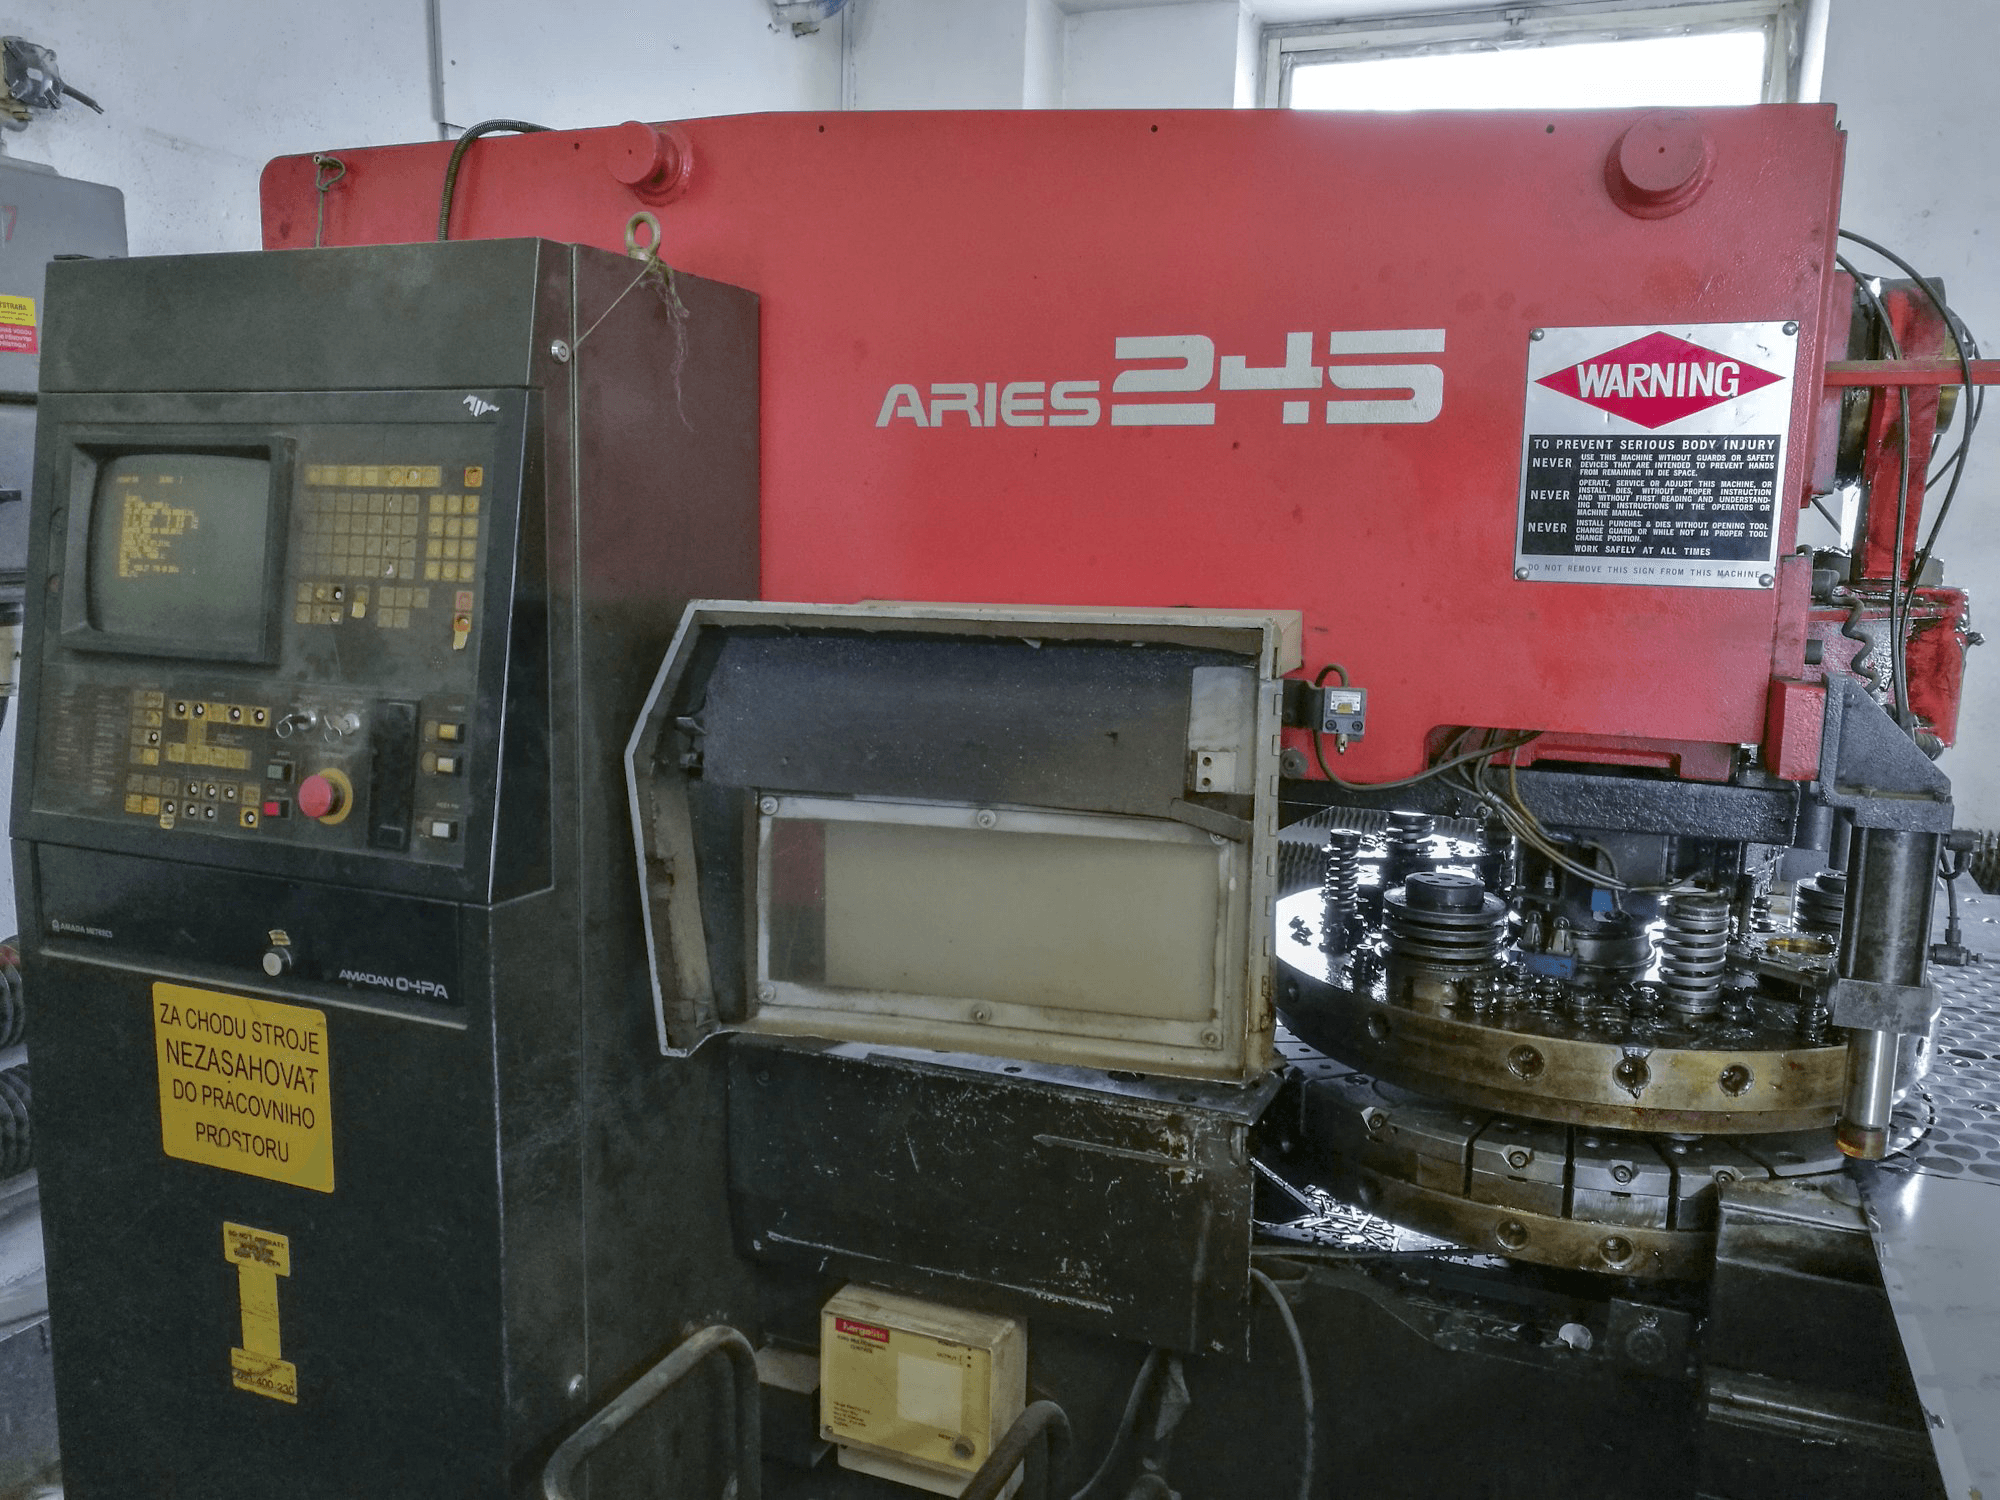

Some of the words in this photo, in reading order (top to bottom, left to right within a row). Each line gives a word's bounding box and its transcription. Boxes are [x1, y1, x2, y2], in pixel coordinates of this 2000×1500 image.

[875, 380, 1101, 427] ARIES
[1110, 328, 1447, 426] 245
[1577, 361, 1740, 399] WARNING
[1533, 439, 1550, 449] TO
[1556, 439, 1614, 450] PREVENT
[1620, 439, 1676, 450] SERIOUS
[1682, 439, 1717, 451] BODY
[1723, 439, 1775, 451] INJURY
[1532, 457, 1572, 468] NEVER
[1581, 453, 1595, 461] USE
[1600, 453, 1616, 461] THIS
[1621, 453, 1653, 461] MACHINE
[1746, 454, 1775, 462] SAFETY
[1748, 462, 1775, 470] HANDS
[1579, 479, 1611, 487] OPERATE,
[1698, 480, 1716, 488] THIS
[1720, 481, 1756, 489] MACHINE,
[1530, 490, 1570, 500] NEVER
[1615, 487, 1633, 495] DIES,
[1720, 488, 1772, 496] INSTRUCTION
[1616, 502, 1670, 510] INSTRUCTIONS
[1611, 509, 1644, 517] MANUAL.
[1527, 522, 1567, 533] NEVER
[1576, 519, 1605, 527] INSTALL
[1675, 521, 1709, 529] WITHOUT
[1712, 522, 1745, 530] OPENING
[1749, 522, 1769, 530] TOOL
[1575, 534, 1603, 542] CHANGE
[1607, 535, 1642, 543] POSITION.
[1700, 529, 1709, 537] IN
[1748, 530, 1768, 538] TOOL
[1574, 544, 1598, 553] WORK
[1604, 545, 1636, 554] SAFELY
[1642, 546, 1654, 555] AT
[1660, 547, 1677, 555] ALL
[1684, 547, 1711, 556] TIMES
[1567, 564, 1601, 573] REMOVE
[1607, 566, 1628, 574] THIS
[1660, 567, 1684, 576] FROM
[1690, 568, 1711, 577] THIS
[60, 922, 86, 934] AMADA
[339, 969, 394, 988] AMADAN
[160, 1003, 182, 1026] ZA
[185, 1008, 246, 1039] CHODU
[251, 1021, 320, 1055] STROJE
[166, 1038, 319, 1095] NEZASAHOVAT
[173, 1078, 197, 1103] DO
[202, 1085, 315, 1130] PRACOVNIHO
[196, 1122, 289, 1163] PROSTORU
